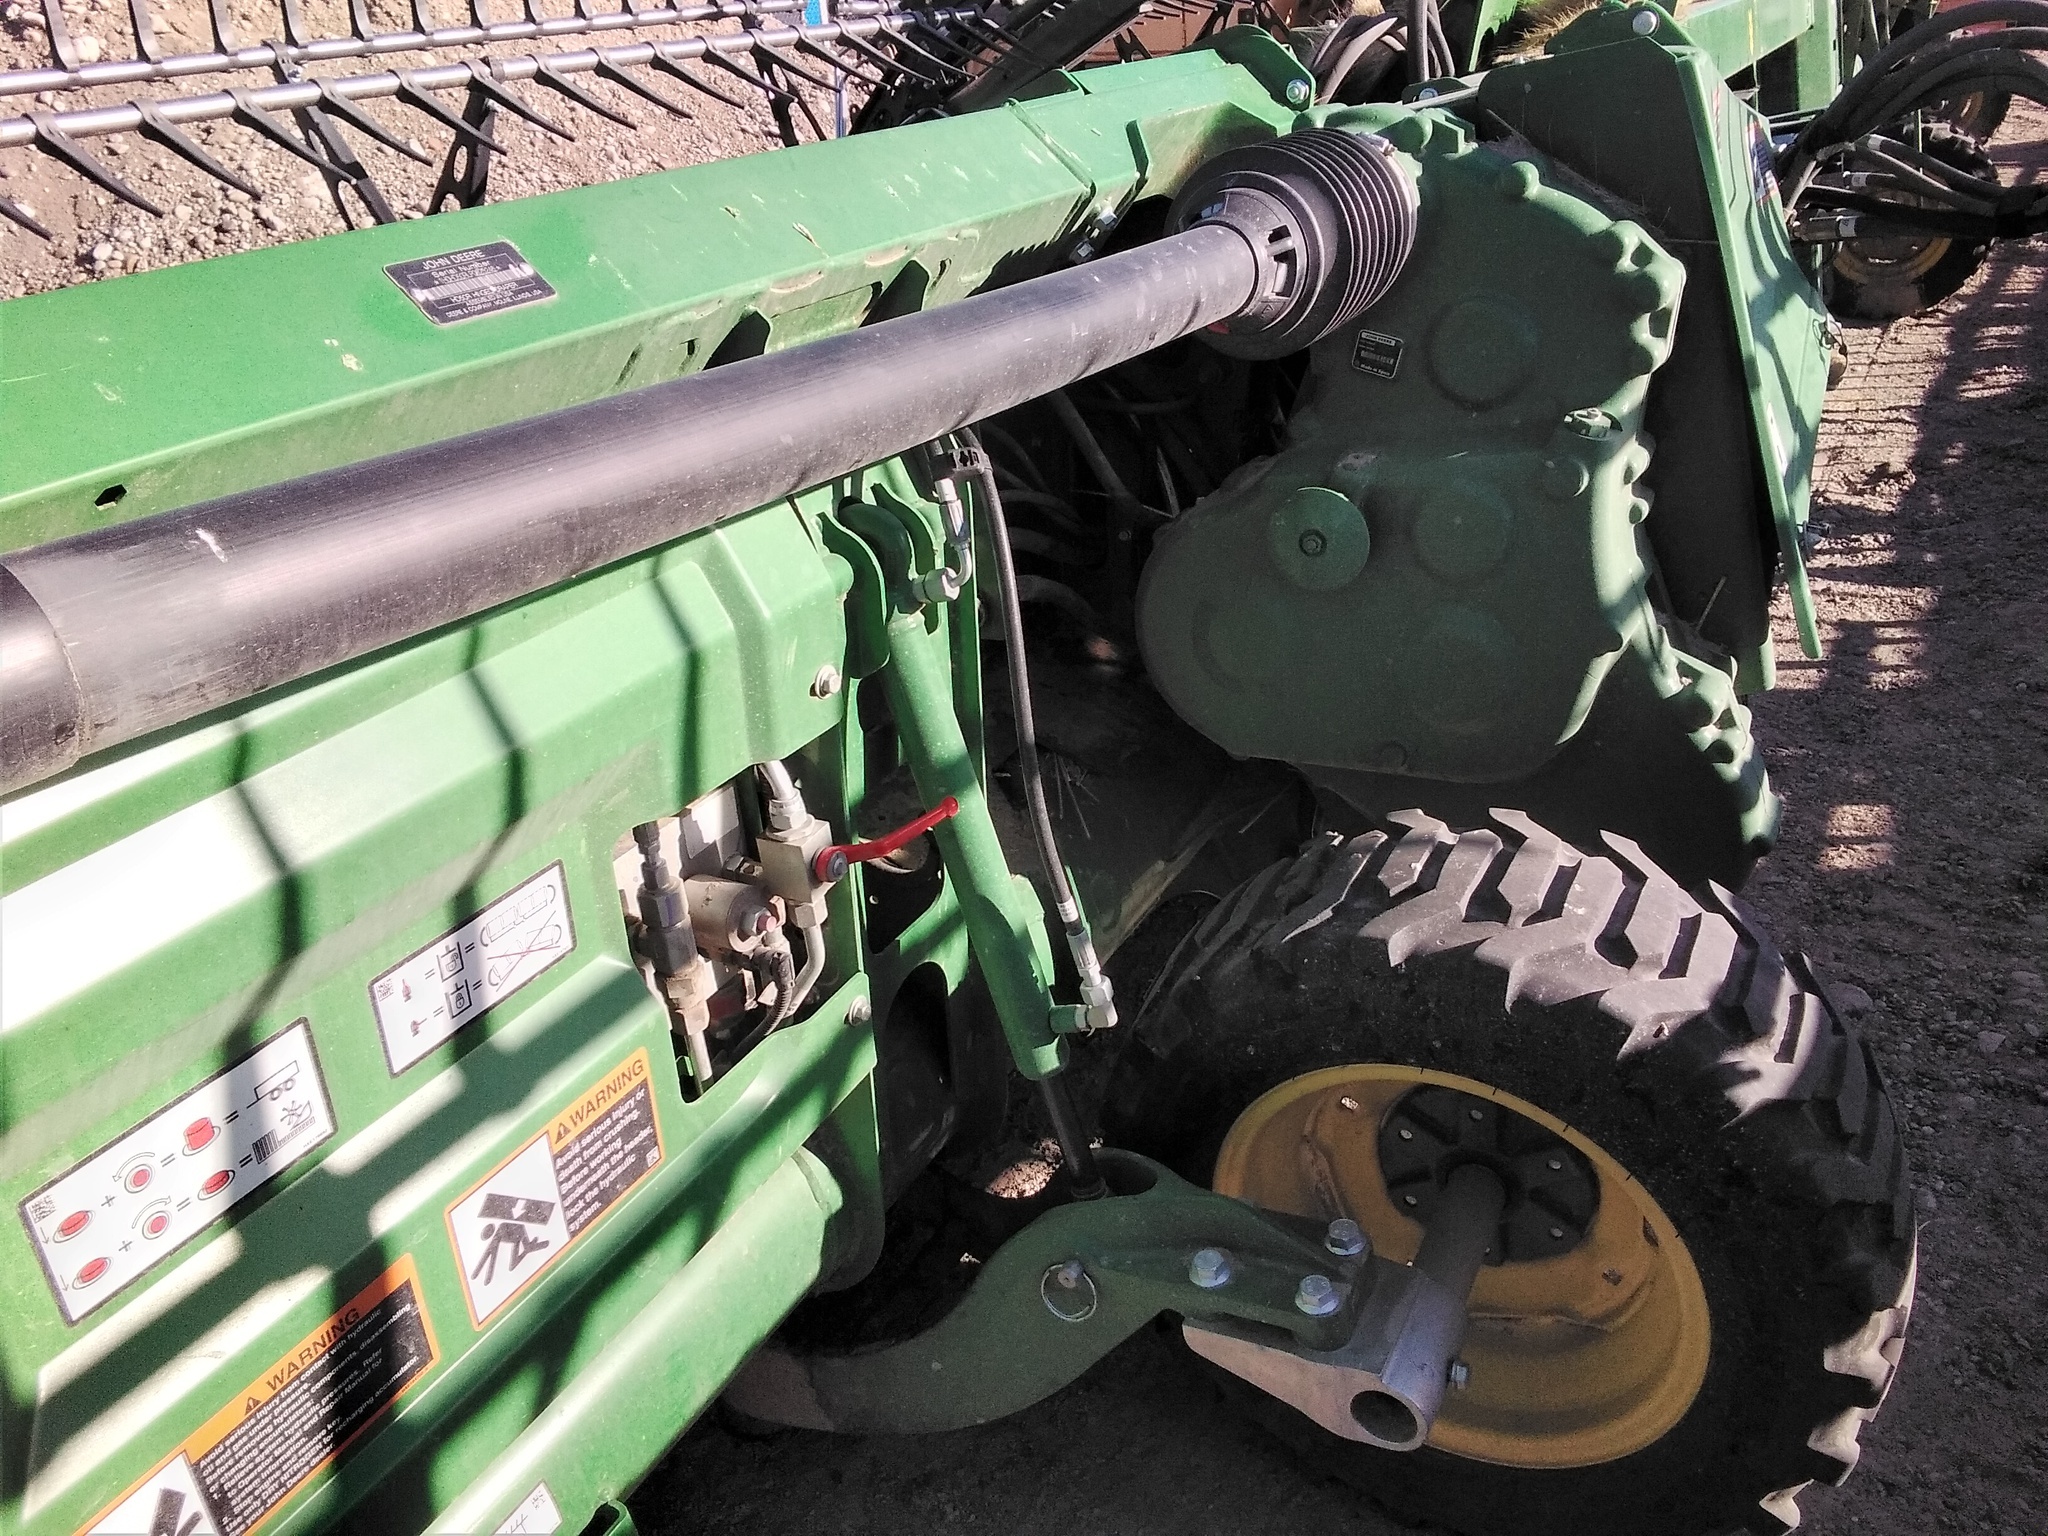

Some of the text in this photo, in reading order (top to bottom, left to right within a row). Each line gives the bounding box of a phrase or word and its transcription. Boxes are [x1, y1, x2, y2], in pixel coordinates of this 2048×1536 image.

[418, 249, 486, 269] JOHN DEERE
[430, 259, 492, 277] Serial Number
[555, 1087, 645, 1169] Avoid serious injury or
[569, 1055, 644, 1131] WARNING
[557, 1105, 640, 1182] death from crushing.
[560, 1135, 622, 1195] Before working
[562, 1121, 653, 1208] underneath the header.
[564, 1150, 636, 1221] lock the hydraulic
[567, 1197, 602, 1235] system.
[198, 1307, 382, 1469] Avoid serious injury from contact with hydraulic
[264, 1305, 360, 1394] WARNING
[201, 1379, 311, 1477] oil and gas under pressure.
[204, 1456, 234, 1485] Before
[233, 1422, 273, 1461] removing
[272, 1390, 310, 1427] hydraulic
[358, 1301, 411, 1351] disassembling
[211, 1489, 221, 1501] 1.
[222, 1460, 255, 1491] Relieve
[253, 1434, 284, 1465] system
[283, 1401, 321, 1438] hydraulic
[362, 1345, 383, 1368] Refer
[226, 1486, 237, 1499] to
[236, 1453, 274, 1491] Operator
[273, 1427, 303, 1457] Manual
[302, 1413, 318, 1431] and
[318, 1390, 344, 1418] Repair
[343, 1366, 371, 1394] Manual
[371, 1355, 383, 1370] for
[208, 1480, 220, 1494] or
[219, 1446, 258, 1484] changing
[221, 1412, 342, 1525] 2. Stop engine and remove key.
[225, 1514, 243, 1533] Use
[242, 1496, 262, 1518] only
[260, 1479, 280, 1500] DRY
[279, 1441, 323, 1484] NITROGEN
[322, 1430, 335, 1445] for
[334, 1394, 374, 1434] recharging
[373, 1353, 419, 1398] accumulator.
[229, 1434, 308, 1507] system information.
[245, 1504, 265, 1526] your
[264, 1485, 286, 1508] John
[285, 1463, 310, 1488] Deere
[309, 1440, 335, 1467] dealer.
